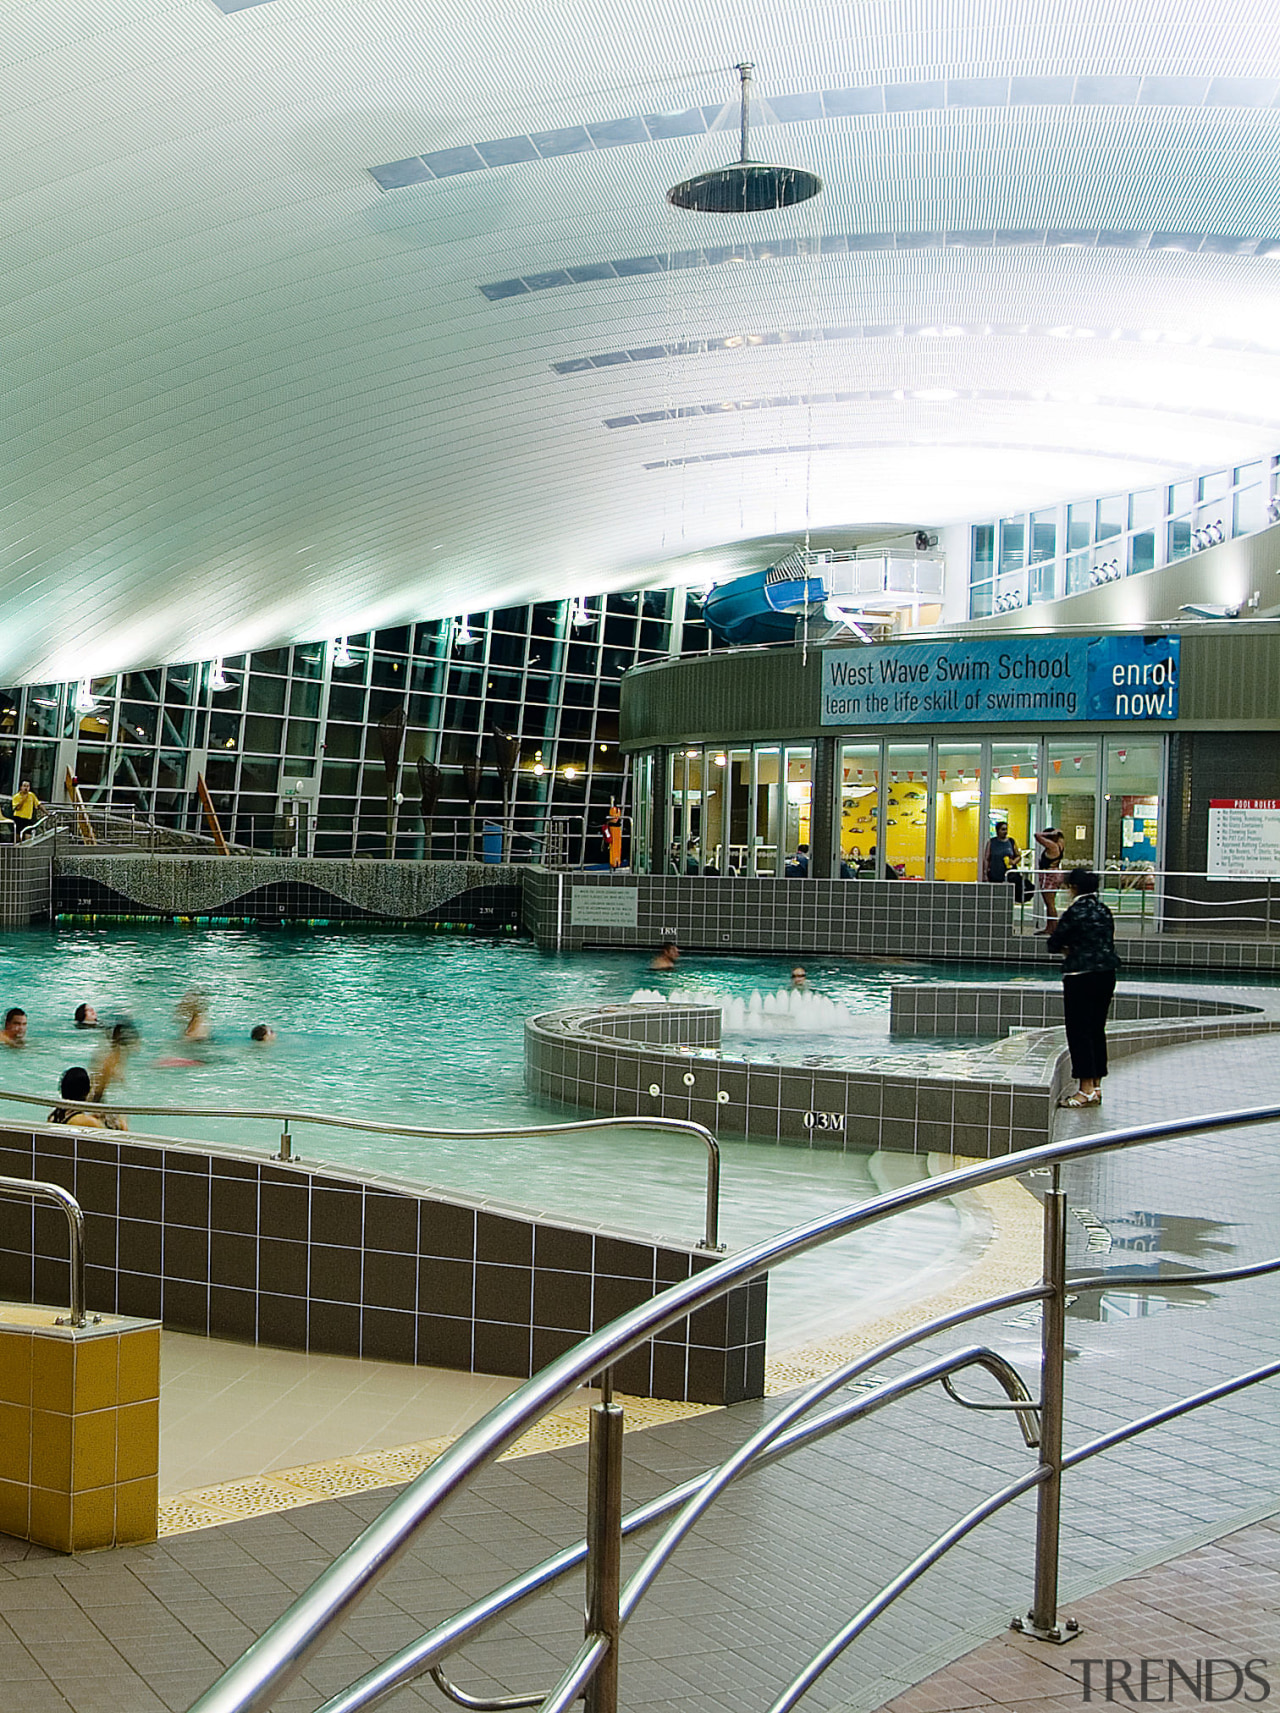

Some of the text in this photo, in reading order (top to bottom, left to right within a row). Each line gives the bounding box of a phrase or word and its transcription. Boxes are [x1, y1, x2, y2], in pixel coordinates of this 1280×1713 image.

[830, 652, 1072, 687] West Wave Swim School
[1112, 656, 1176, 686] enrol
[826, 687, 1077, 715] learn the life skill of swimming
[1115, 686, 1173, 716] now!
[1234, 800, 1276, 809] POOL RULES
